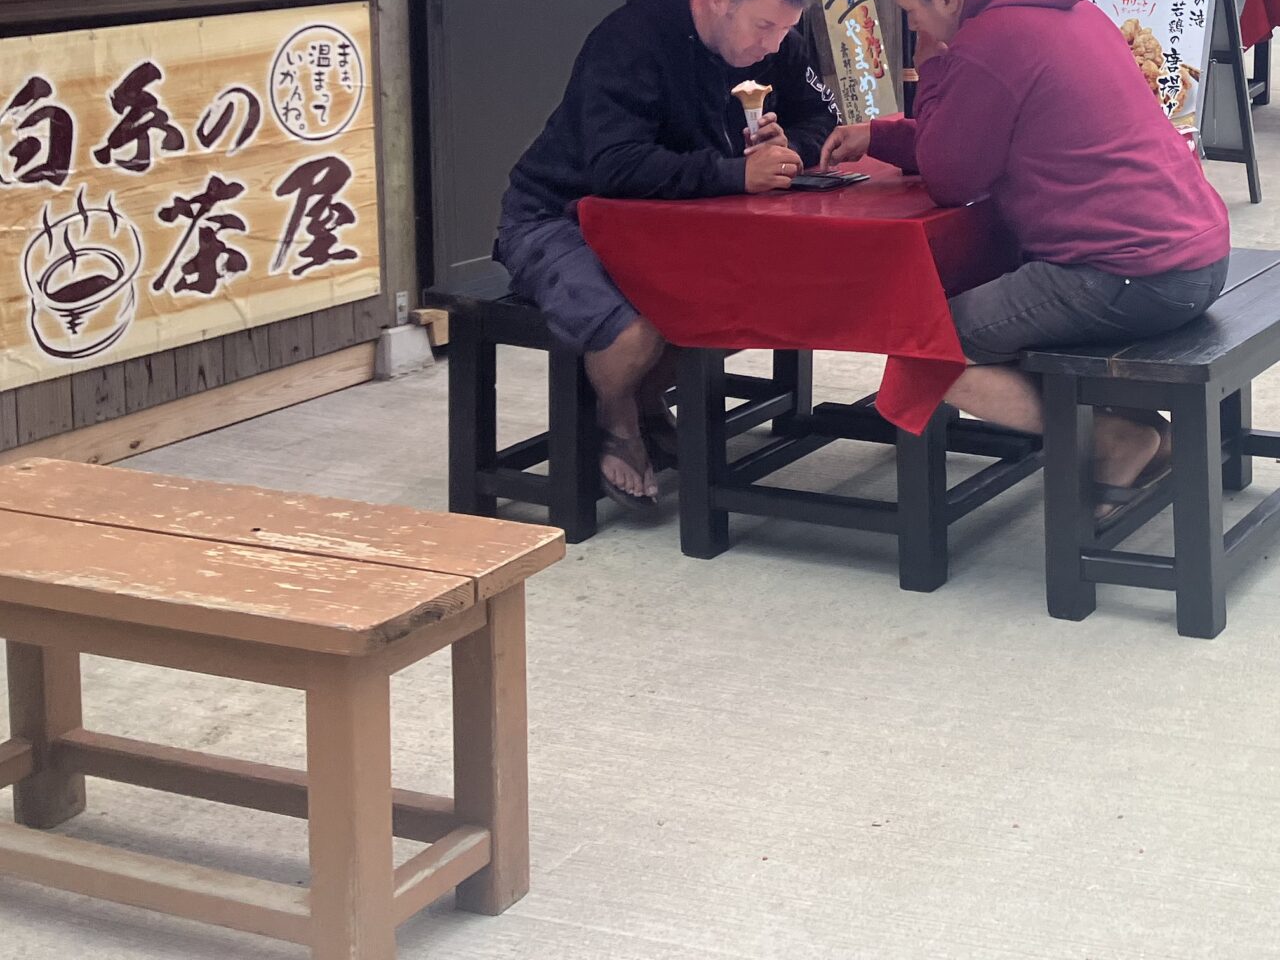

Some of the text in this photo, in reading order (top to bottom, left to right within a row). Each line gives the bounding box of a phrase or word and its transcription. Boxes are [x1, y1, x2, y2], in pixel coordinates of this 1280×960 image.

[0, 62, 260, 186] 白糸の
[308, 44, 332, 123] 温まって
[152, 155, 358, 295] 茶屋
